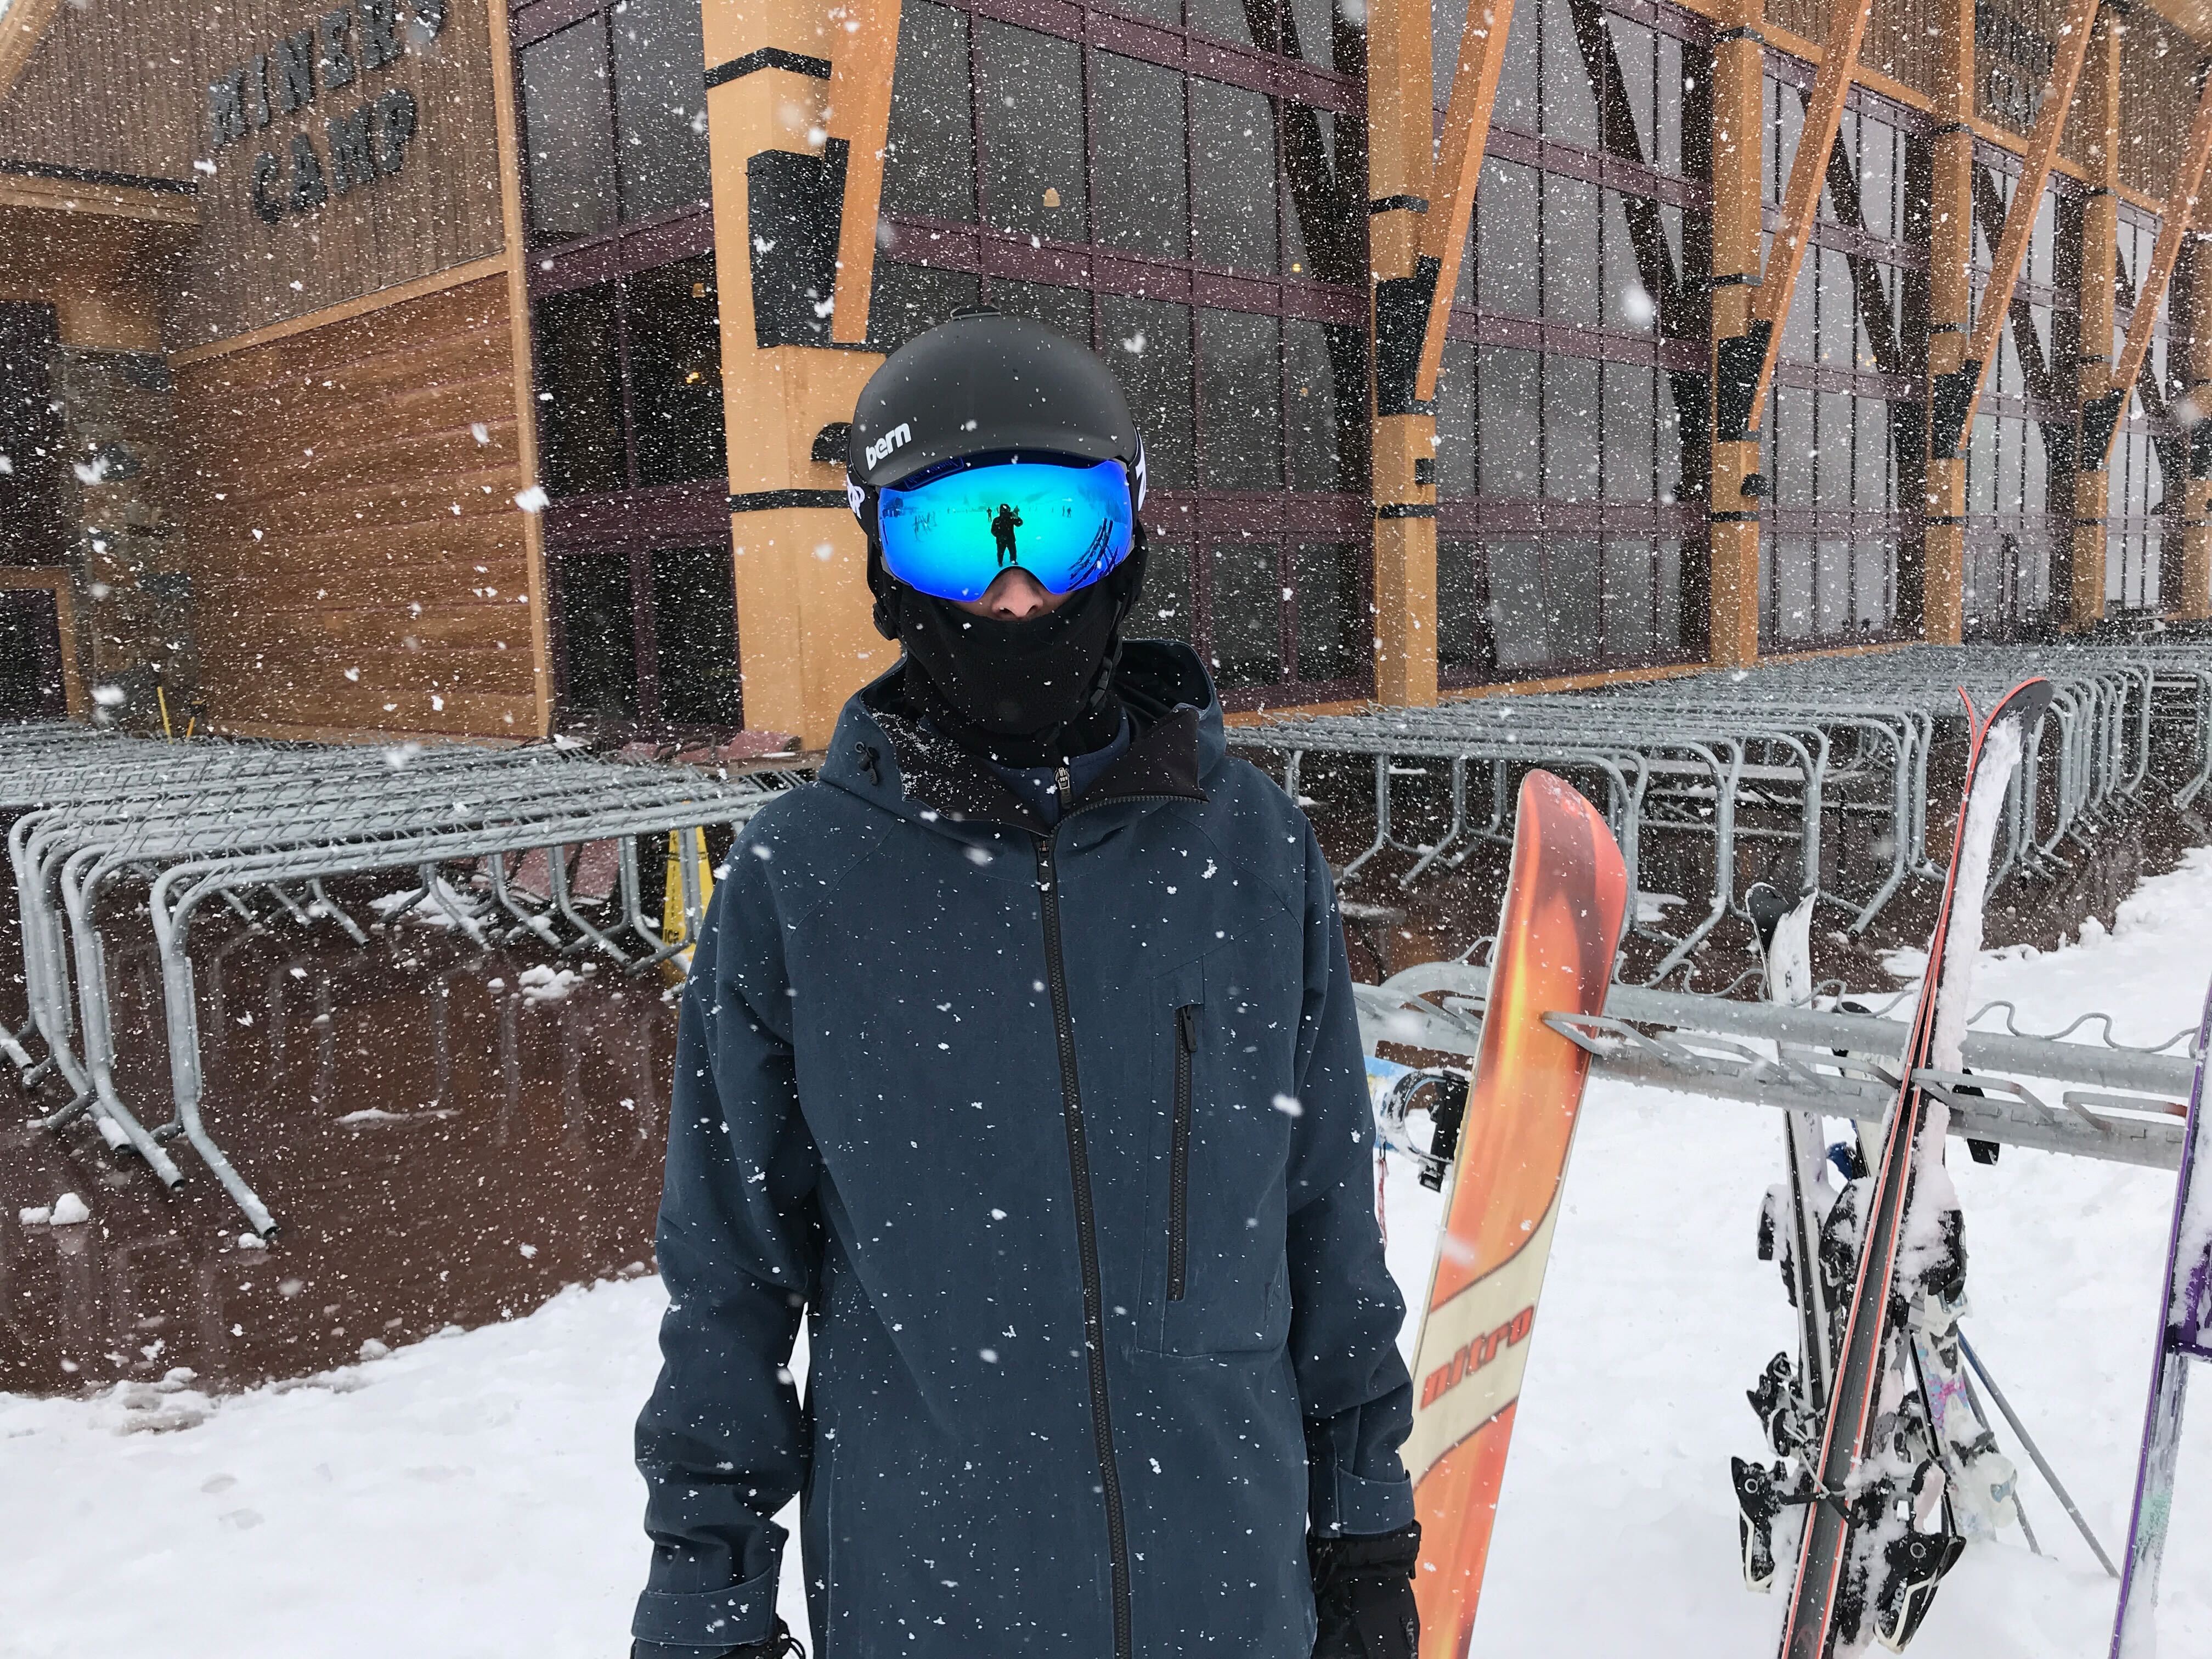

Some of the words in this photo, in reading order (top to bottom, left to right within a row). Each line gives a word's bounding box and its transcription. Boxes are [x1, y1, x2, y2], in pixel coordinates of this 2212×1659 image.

[253, 88, 418, 225] CAMP
[866, 423, 912, 471] bern
[1419, 1305, 1534, 1411] nitro
